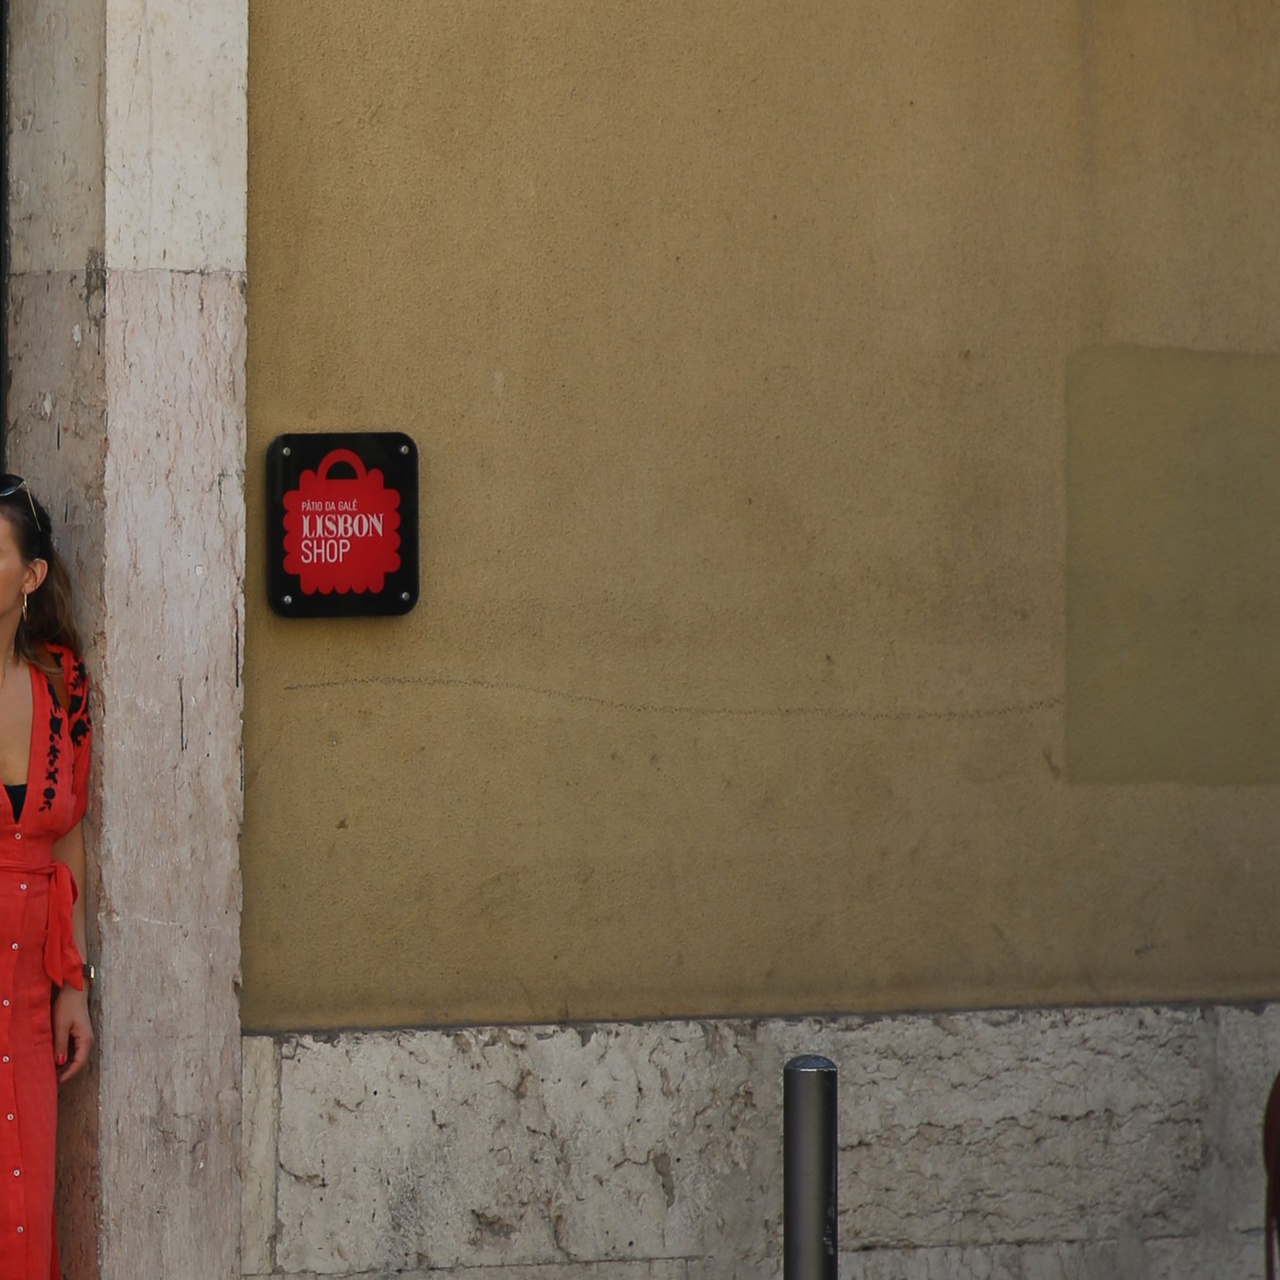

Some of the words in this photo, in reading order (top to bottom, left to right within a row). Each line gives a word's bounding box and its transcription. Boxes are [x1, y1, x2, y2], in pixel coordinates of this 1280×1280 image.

[301, 499, 323, 512] PÁTIO
[325, 500, 336, 511] DA
[338, 498, 358, 511] GALÉ
[301, 513, 384, 538] LISBON
[301, 539, 351, 563] SHOP
